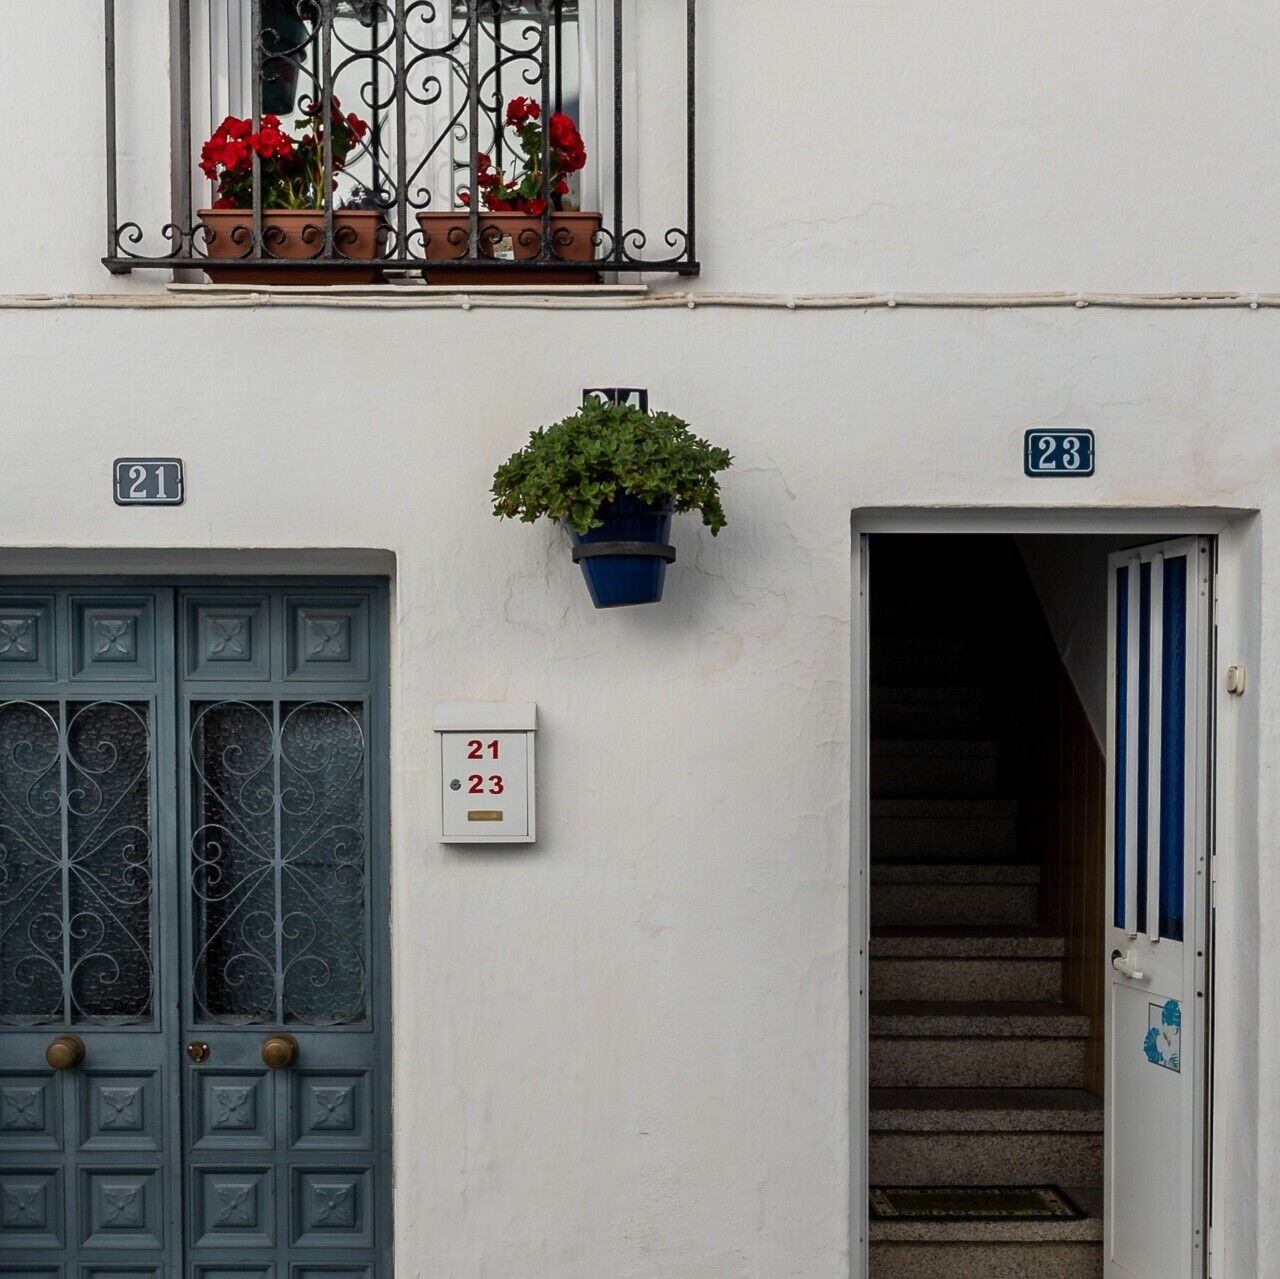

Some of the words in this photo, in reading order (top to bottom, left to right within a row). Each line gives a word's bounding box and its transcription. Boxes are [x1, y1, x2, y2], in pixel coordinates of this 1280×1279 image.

[1038, 436, 1080, 469] 23
[128, 465, 167, 498] 21
[467, 739, 499, 760] 21
[467, 774, 505, 795] 23
